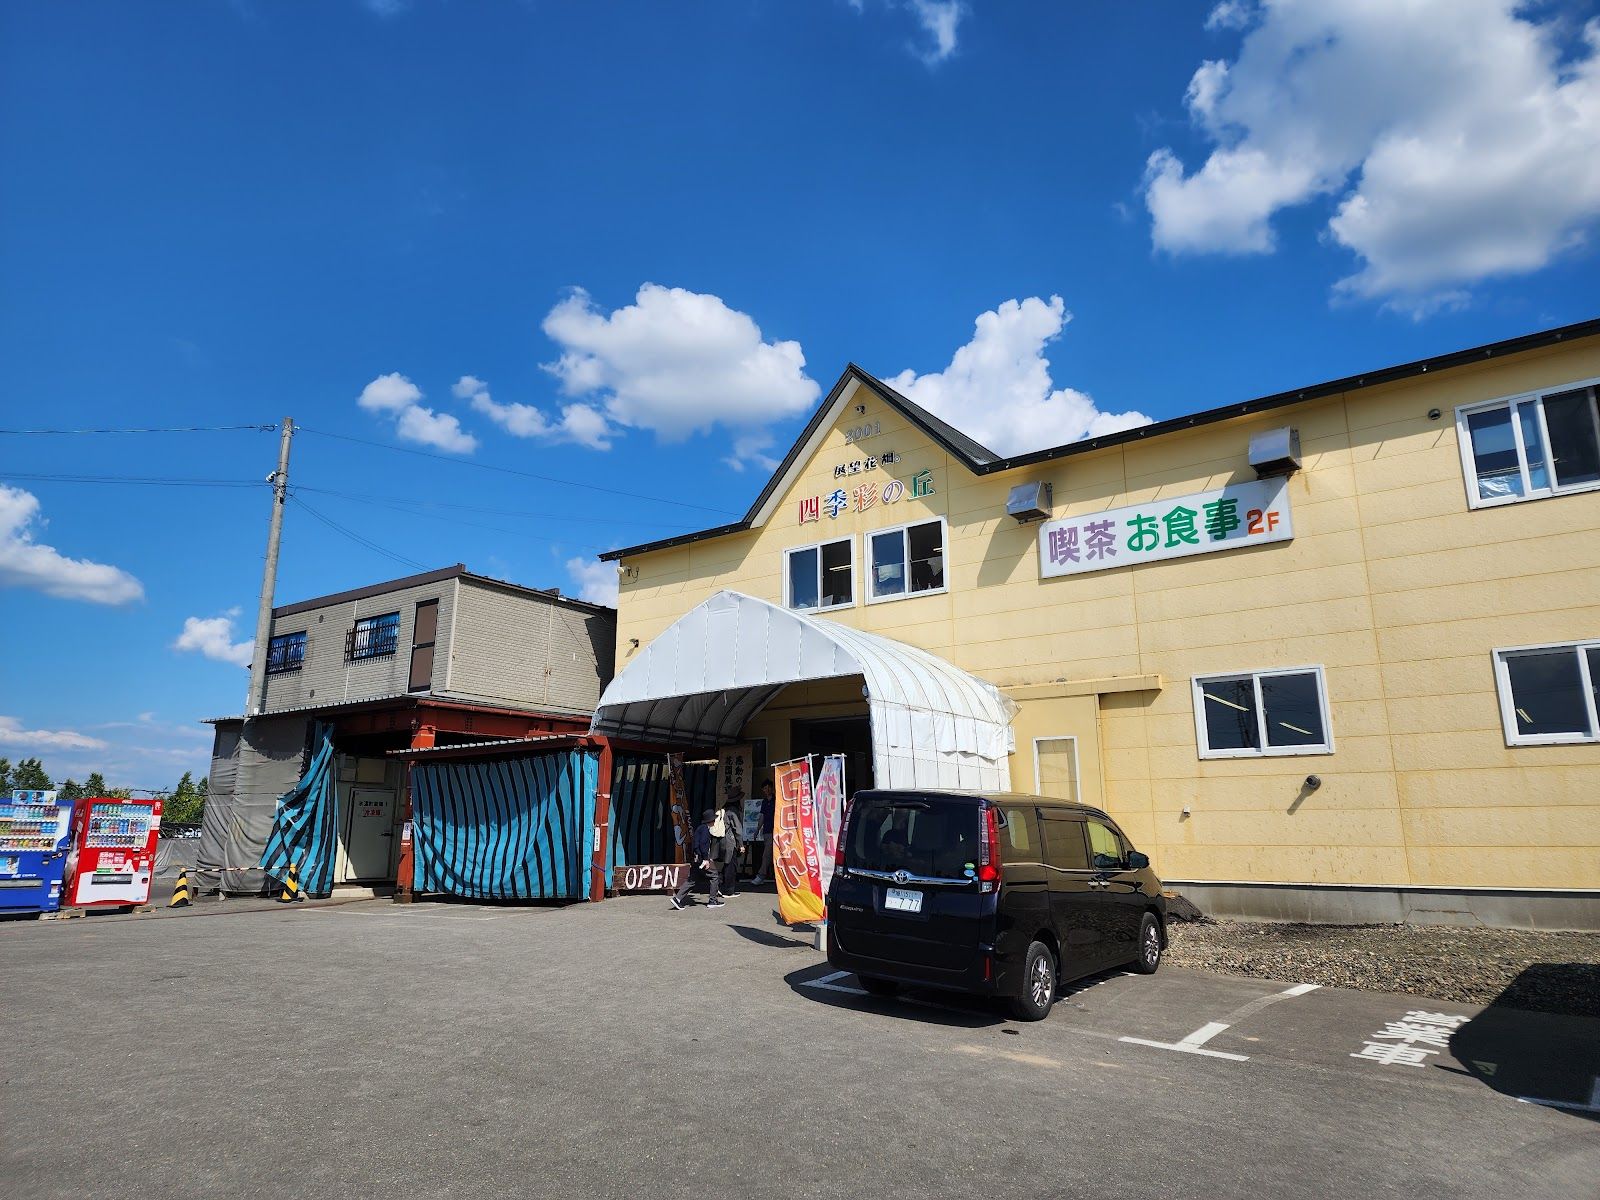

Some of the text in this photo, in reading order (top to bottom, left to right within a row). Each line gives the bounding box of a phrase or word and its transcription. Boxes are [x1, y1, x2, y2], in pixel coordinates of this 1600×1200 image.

[799, 469, 936, 525] 四季彩の丘
[1048, 497, 1280, 566] 喫茶 お食事 2F
[625, 865, 680, 890] OPEN
